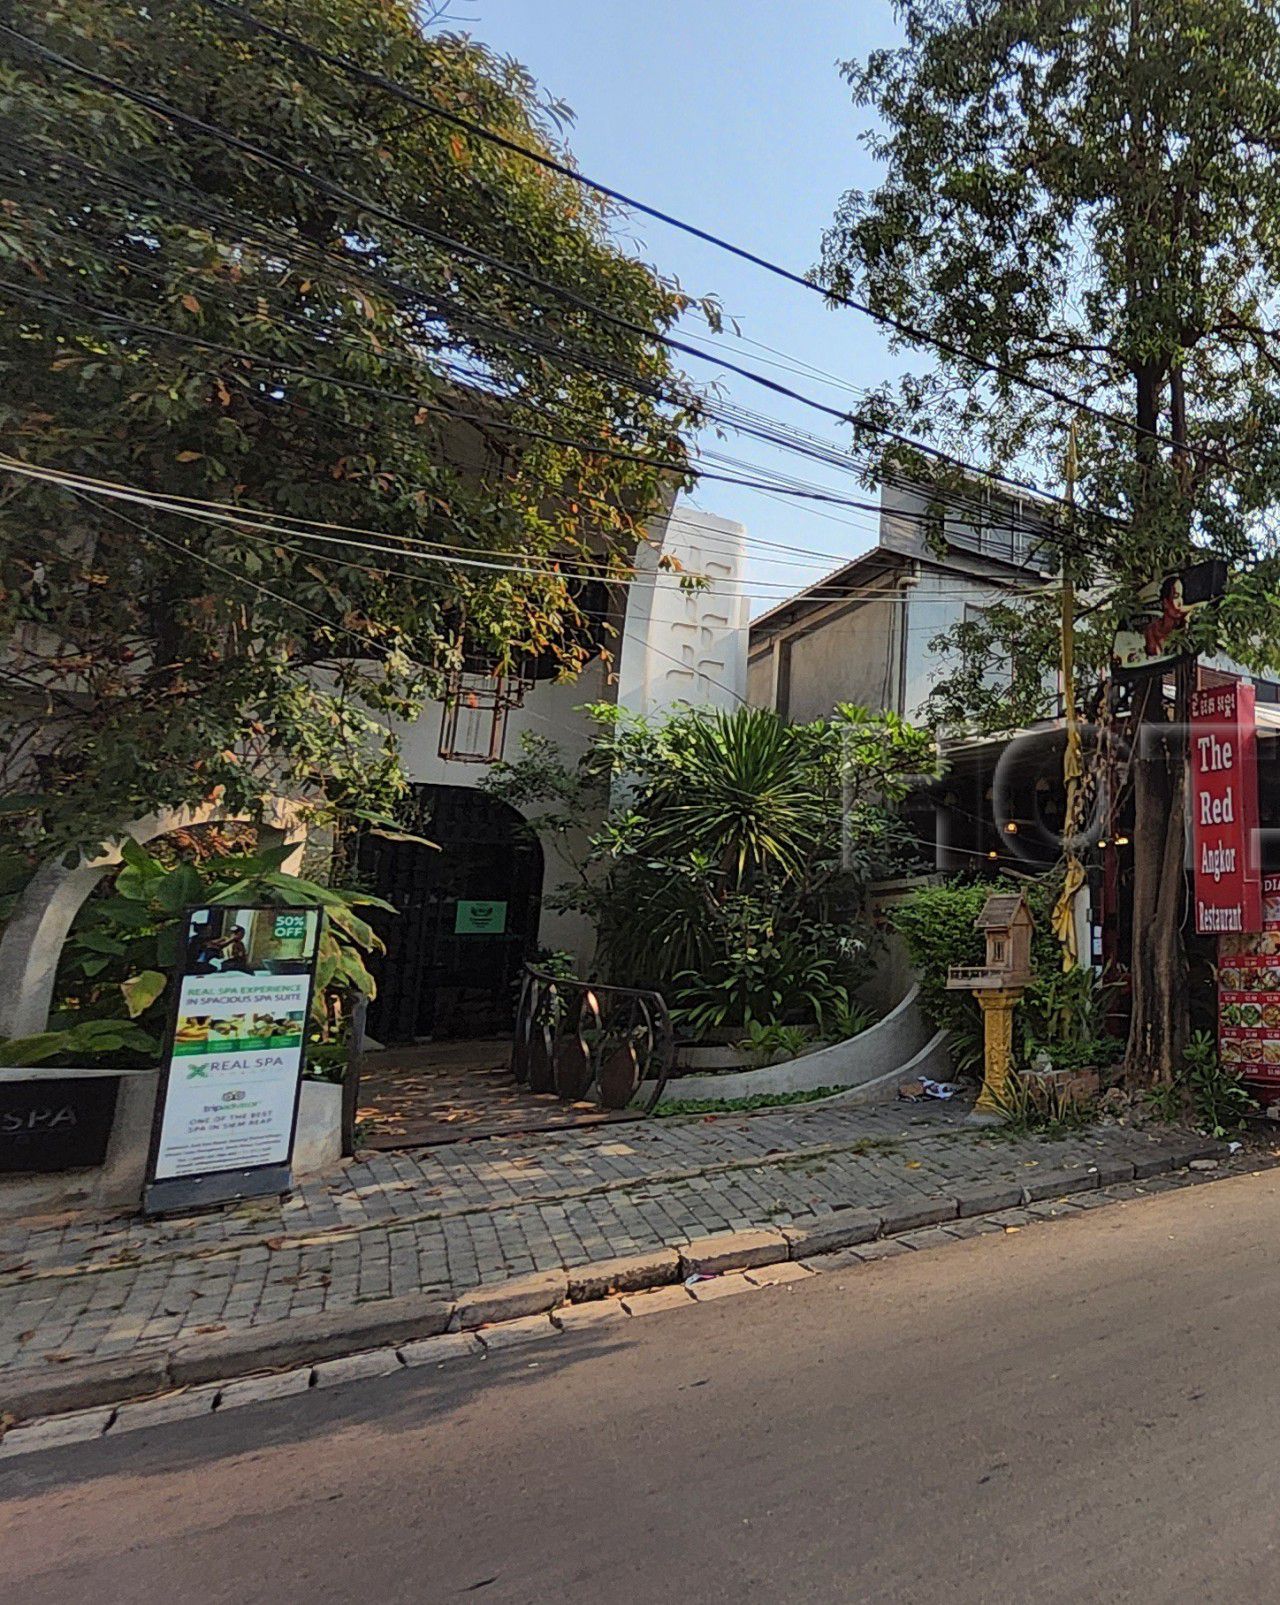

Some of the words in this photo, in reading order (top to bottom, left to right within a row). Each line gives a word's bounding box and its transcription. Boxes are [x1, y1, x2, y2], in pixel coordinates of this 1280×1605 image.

[1198, 734, 1232, 772] The
[1200, 787, 1234, 825] Red
[1202, 840, 1235, 882] Angkor
[276, 916, 304, 926] 50%
[1199, 902, 1242, 931] Restaurant
[275, 928, 303, 937] OFF
[188, 987, 214, 996] REAL
[218, 986, 238, 995] SPA
[241, 984, 301, 994] EXPERIENCE
[201, 995, 251, 1004] SPACIOUS
[254, 994, 272, 1002] SPA
[210, 1060, 250, 1071] REAL
[255, 1057, 283, 1067] SPA
[1, 1105, 77, 1131] SPA
